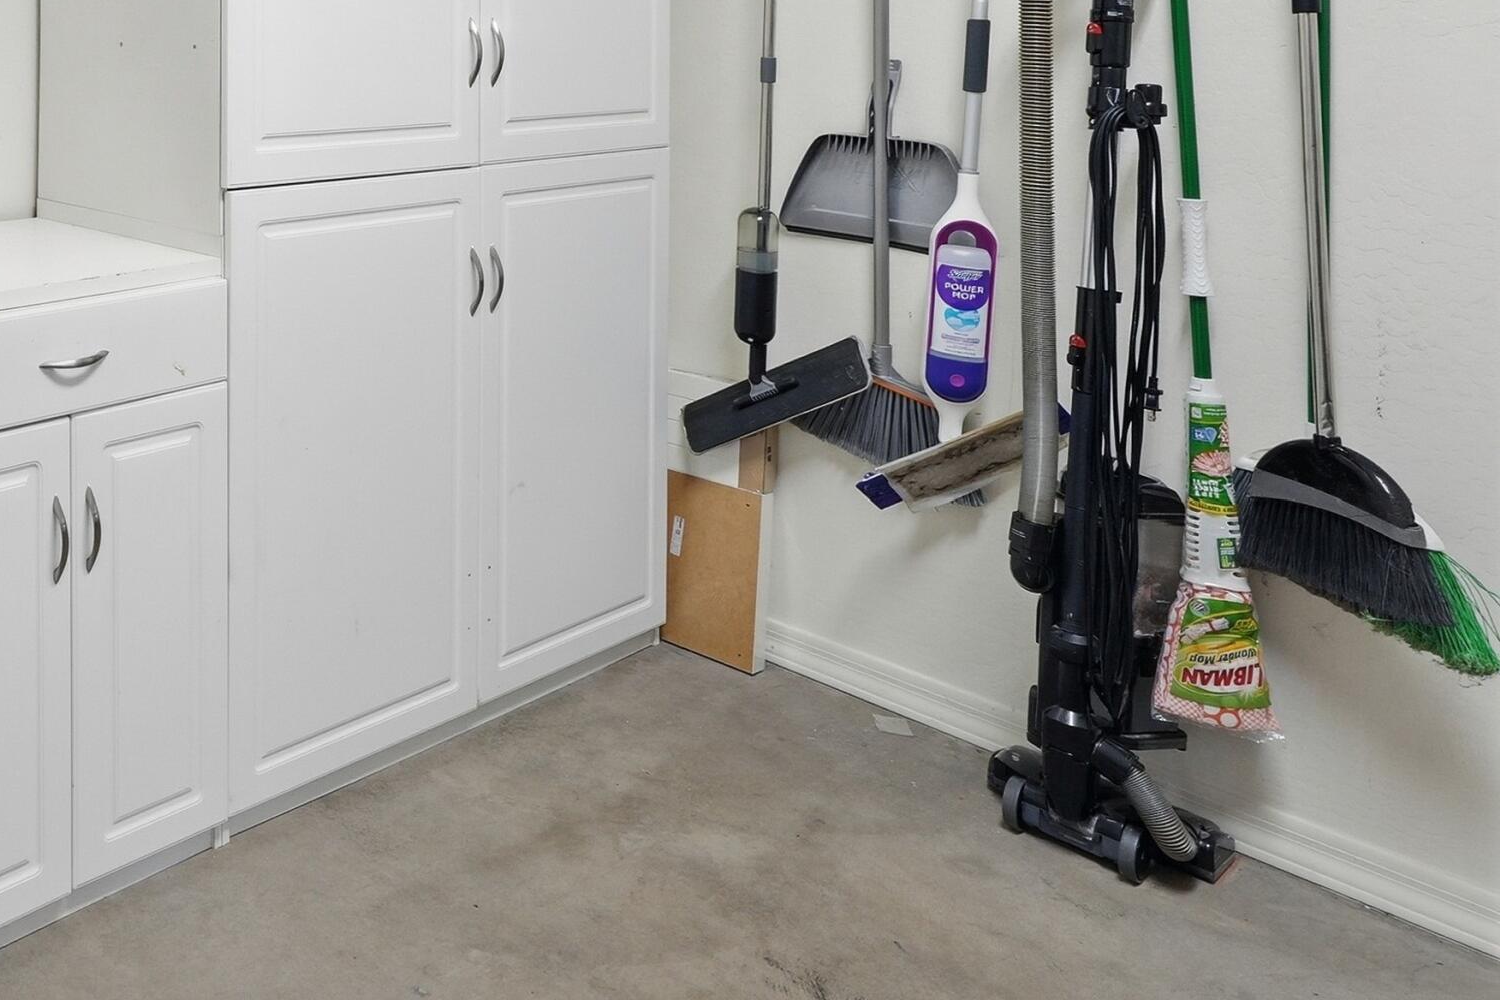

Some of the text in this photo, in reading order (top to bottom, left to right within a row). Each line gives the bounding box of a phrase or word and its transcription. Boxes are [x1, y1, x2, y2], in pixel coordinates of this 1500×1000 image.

[944, 282, 984, 294] POWER
[1189, 647, 1257, 665] Wonder Mop
[1181, 662, 1263, 688] LIBMAN
